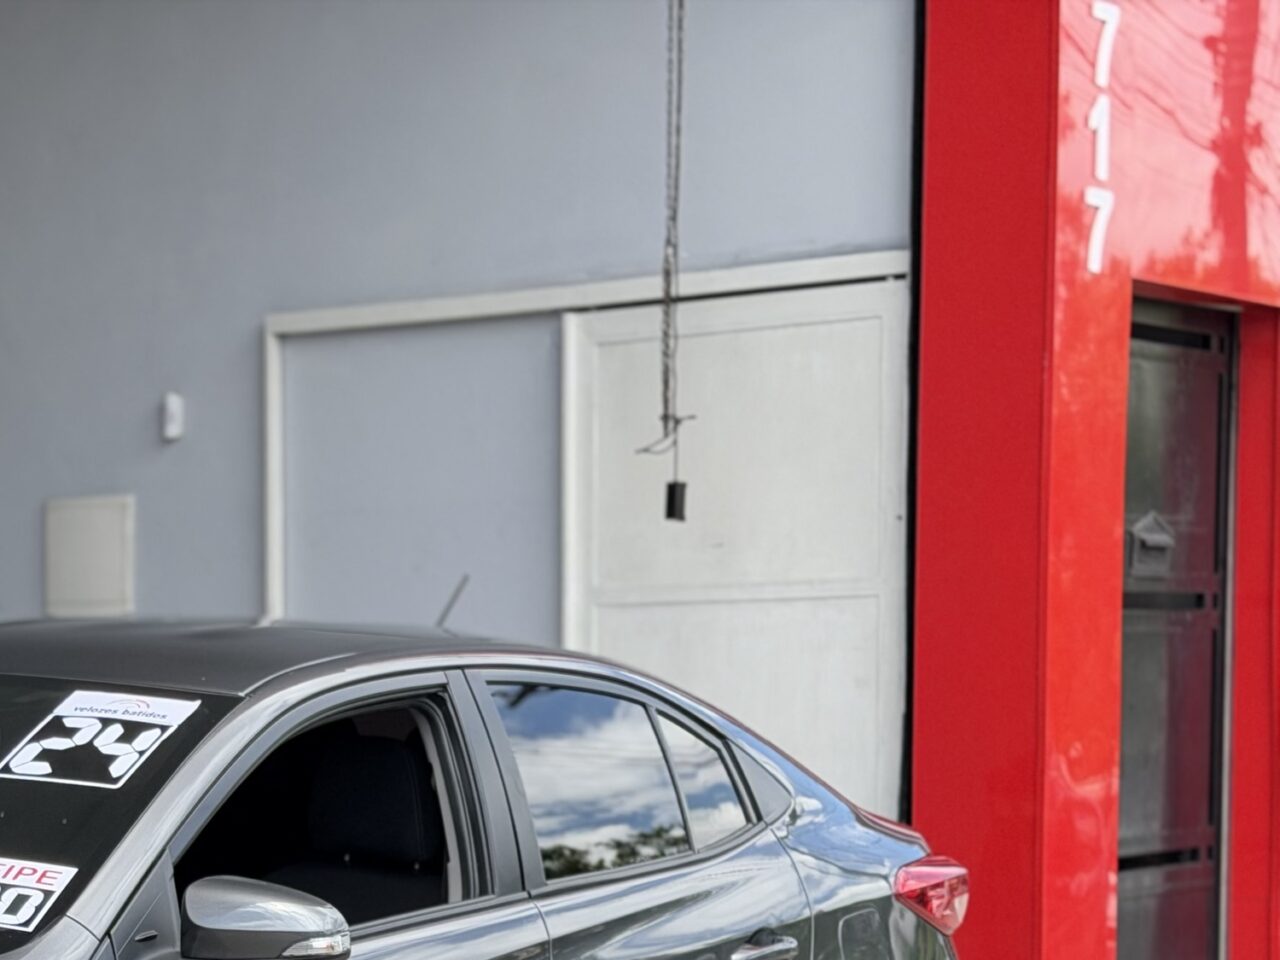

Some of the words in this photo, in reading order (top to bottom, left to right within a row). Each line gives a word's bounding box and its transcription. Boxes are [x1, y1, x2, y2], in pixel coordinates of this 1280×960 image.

[1083, 1, 1122, 274] 717
[74, 705, 119, 714] velozes
[121, 708, 169, 719] batidos
[9, 716, 162, 778] 24
